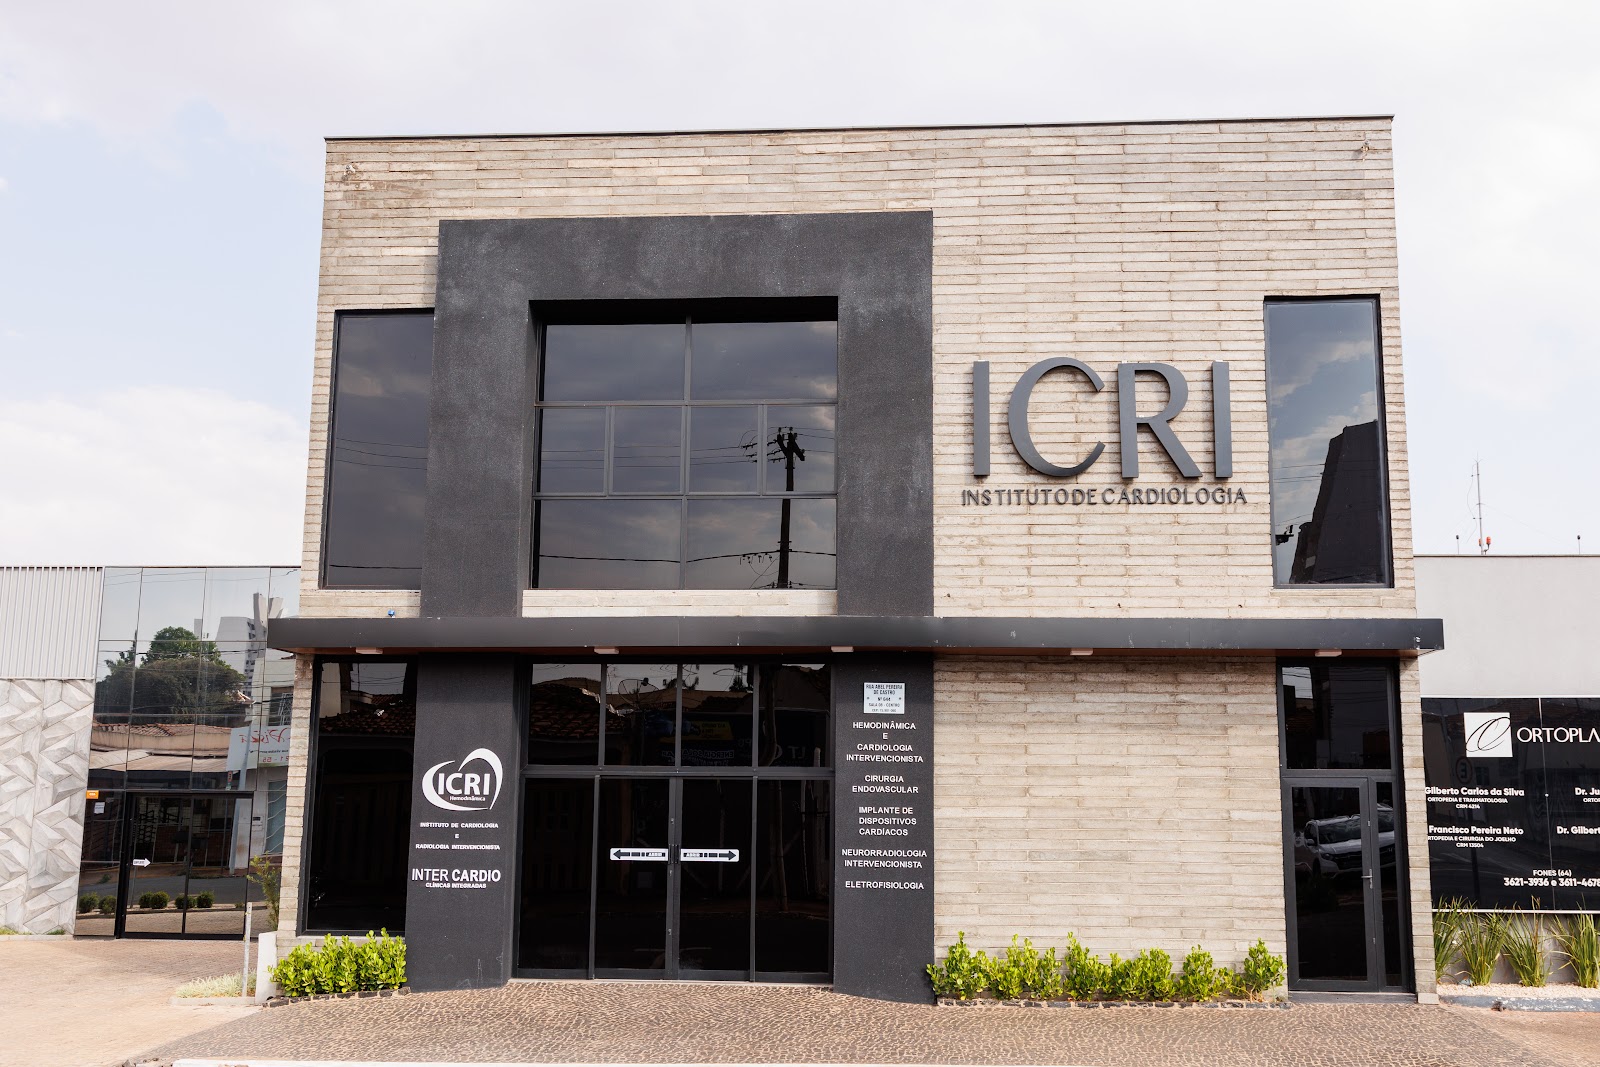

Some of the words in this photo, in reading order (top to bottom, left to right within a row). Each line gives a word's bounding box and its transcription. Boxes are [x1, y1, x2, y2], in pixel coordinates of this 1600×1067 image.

[972, 357, 1233, 479] ICRI
[961, 488, 1069, 506] INSTITUTO
[1071, 488, 1097, 505] DE
[1101, 487, 1248, 505] CARDIOLOGIA
[852, 721, 916, 730] HEMODINÂMICA
[856, 743, 913, 751] CARDIOLOGIA
[846, 754, 923, 762] INTERVENCIONISTA
[864, 775, 904, 783] CIRURGIA
[438, 773, 490, 795] ICRI
[852, 786, 919, 794] ENDOVASCULAR
[1425, 787, 1459, 795] Gilberto
[1461, 787, 1489, 796] Carlos
[1490, 788, 1503, 796] da
[1503, 788, 1525, 796] Silva
[1575, 787, 1588, 796] Dr.
[859, 828, 908, 836] CARDÍACOS
[1429, 825, 1470, 834] Francisco
[1471, 826, 1502, 834] Pereira
[1503, 827, 1524, 835] Neto
[1557, 826, 1571, 835] Dr.
[841, 849, 927, 857] NEURORRADIOLOGIA
[844, 860, 922, 868] INTERVENCIONISTA
[412, 868, 449, 881] INTER
[451, 869, 501, 882] CARDIO
[845, 881, 924, 889] ELETROFISIOLOGIA
[1503, 877, 1550, 887] 3621-3936
